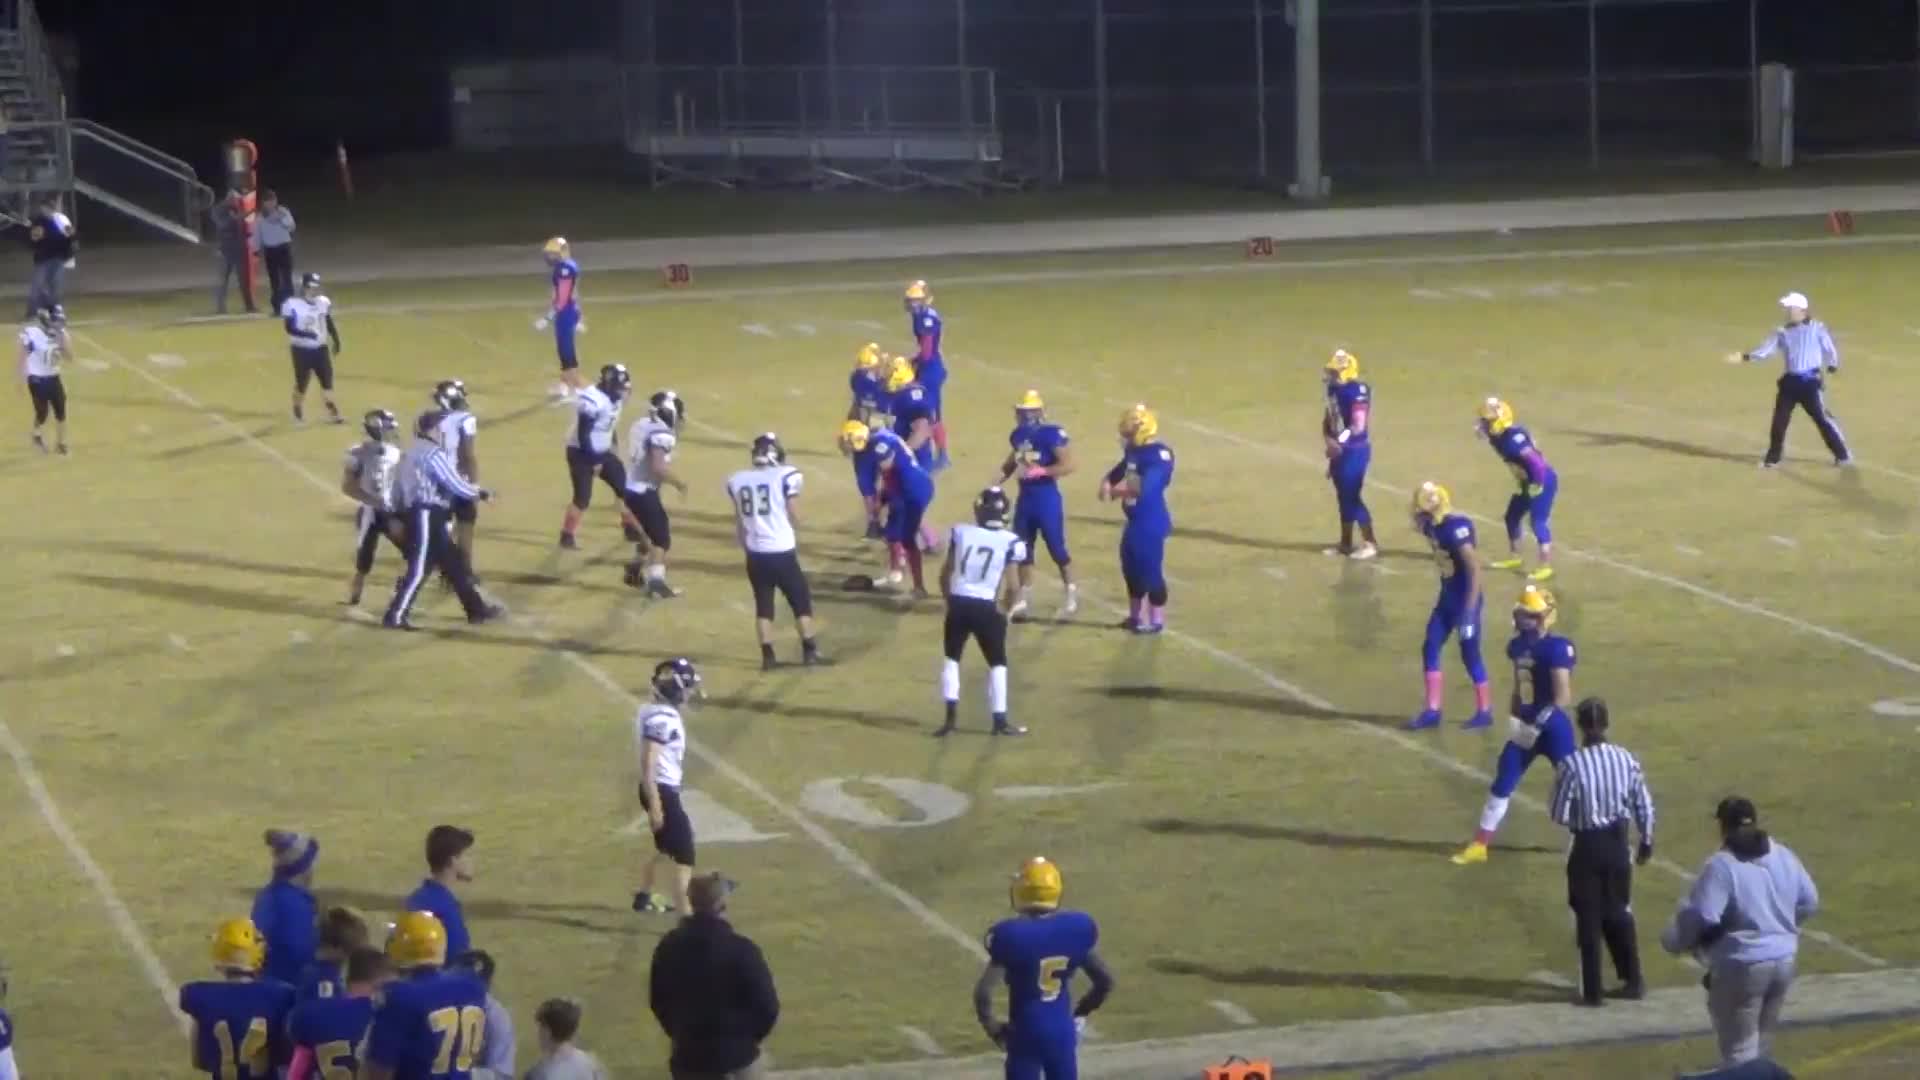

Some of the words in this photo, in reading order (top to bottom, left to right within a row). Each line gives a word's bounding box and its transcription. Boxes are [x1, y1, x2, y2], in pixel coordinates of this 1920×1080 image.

[1252, 236, 1273, 256] 20
[668, 263, 690, 283] 30
[738, 483, 770, 516] 83
[960, 544, 995, 581] 17
[1039, 955, 1071, 1002] 5
[212, 1016, 268, 1080] 14
[427, 1004, 487, 1075] 70
